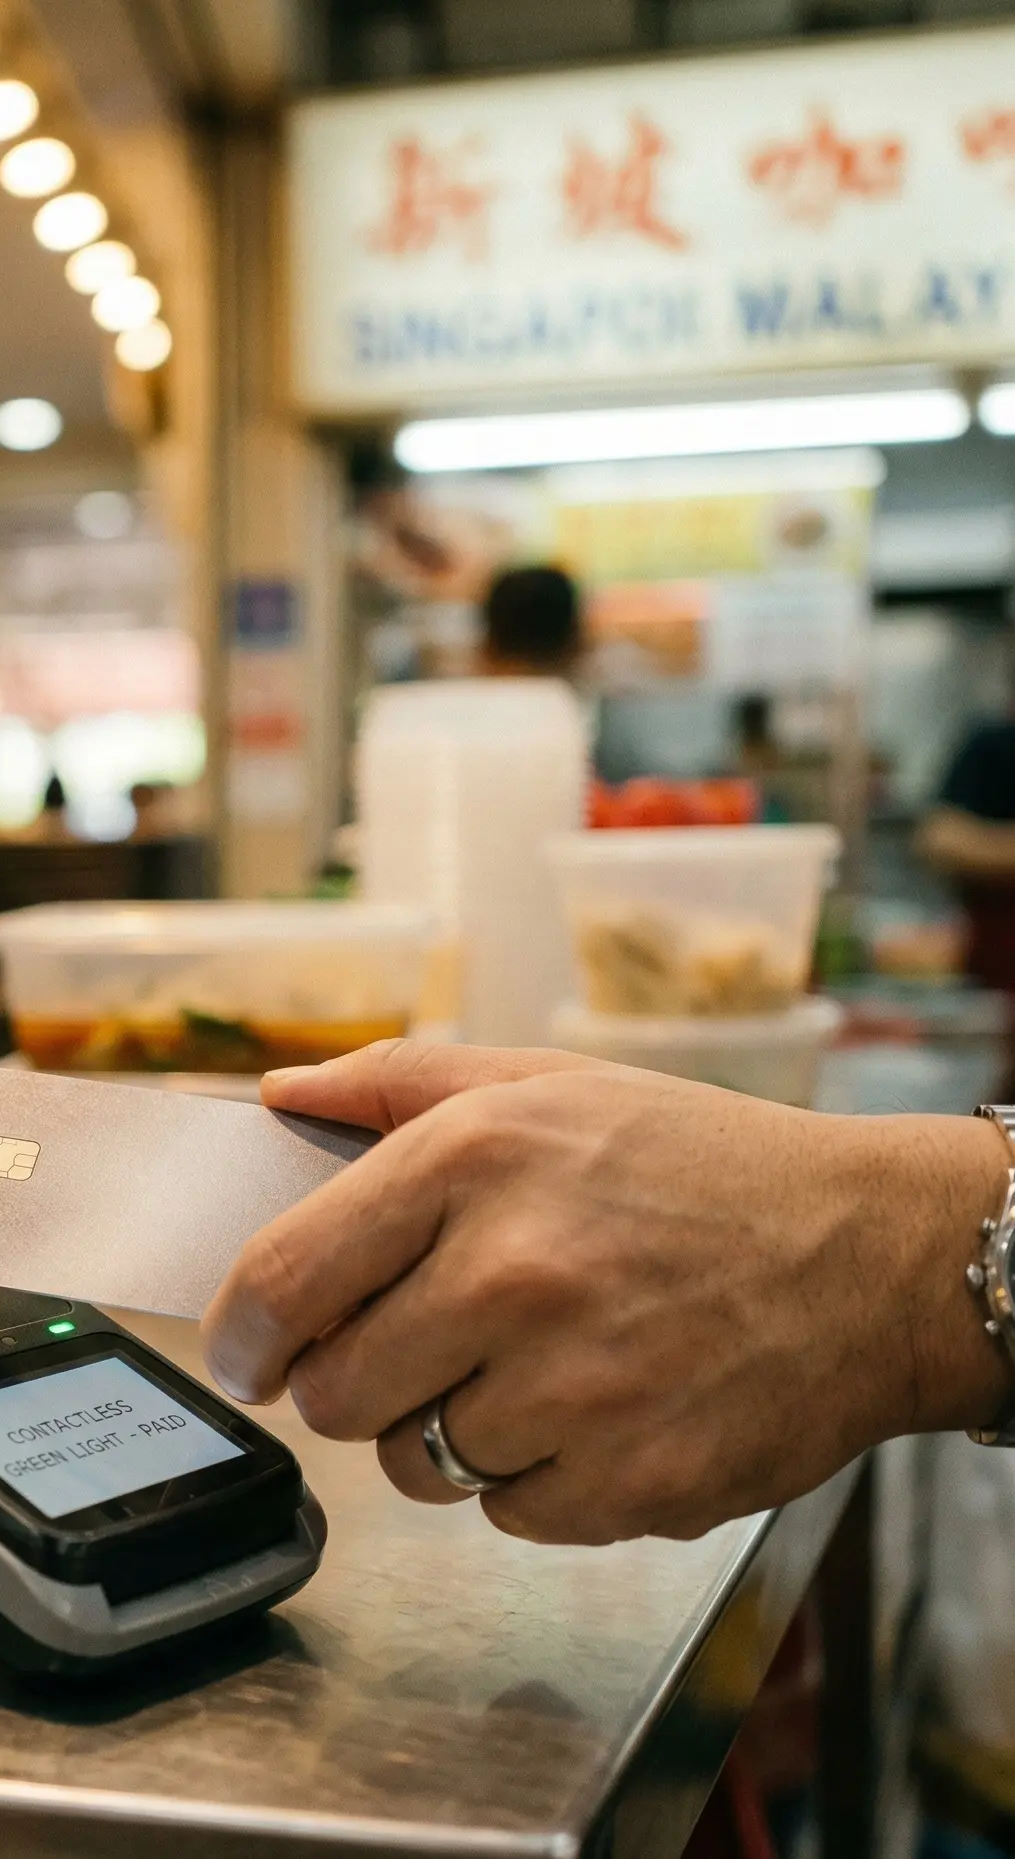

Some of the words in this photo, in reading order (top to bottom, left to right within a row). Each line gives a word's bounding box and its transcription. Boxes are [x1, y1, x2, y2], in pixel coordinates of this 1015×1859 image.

[4, 1451, 69, 1478] GREEN
[66, 1432, 125, 1459] LIGHT
[138, 1414, 187, 1438] PAID
[7, 1399, 133, 1444] CONTACTLESS
